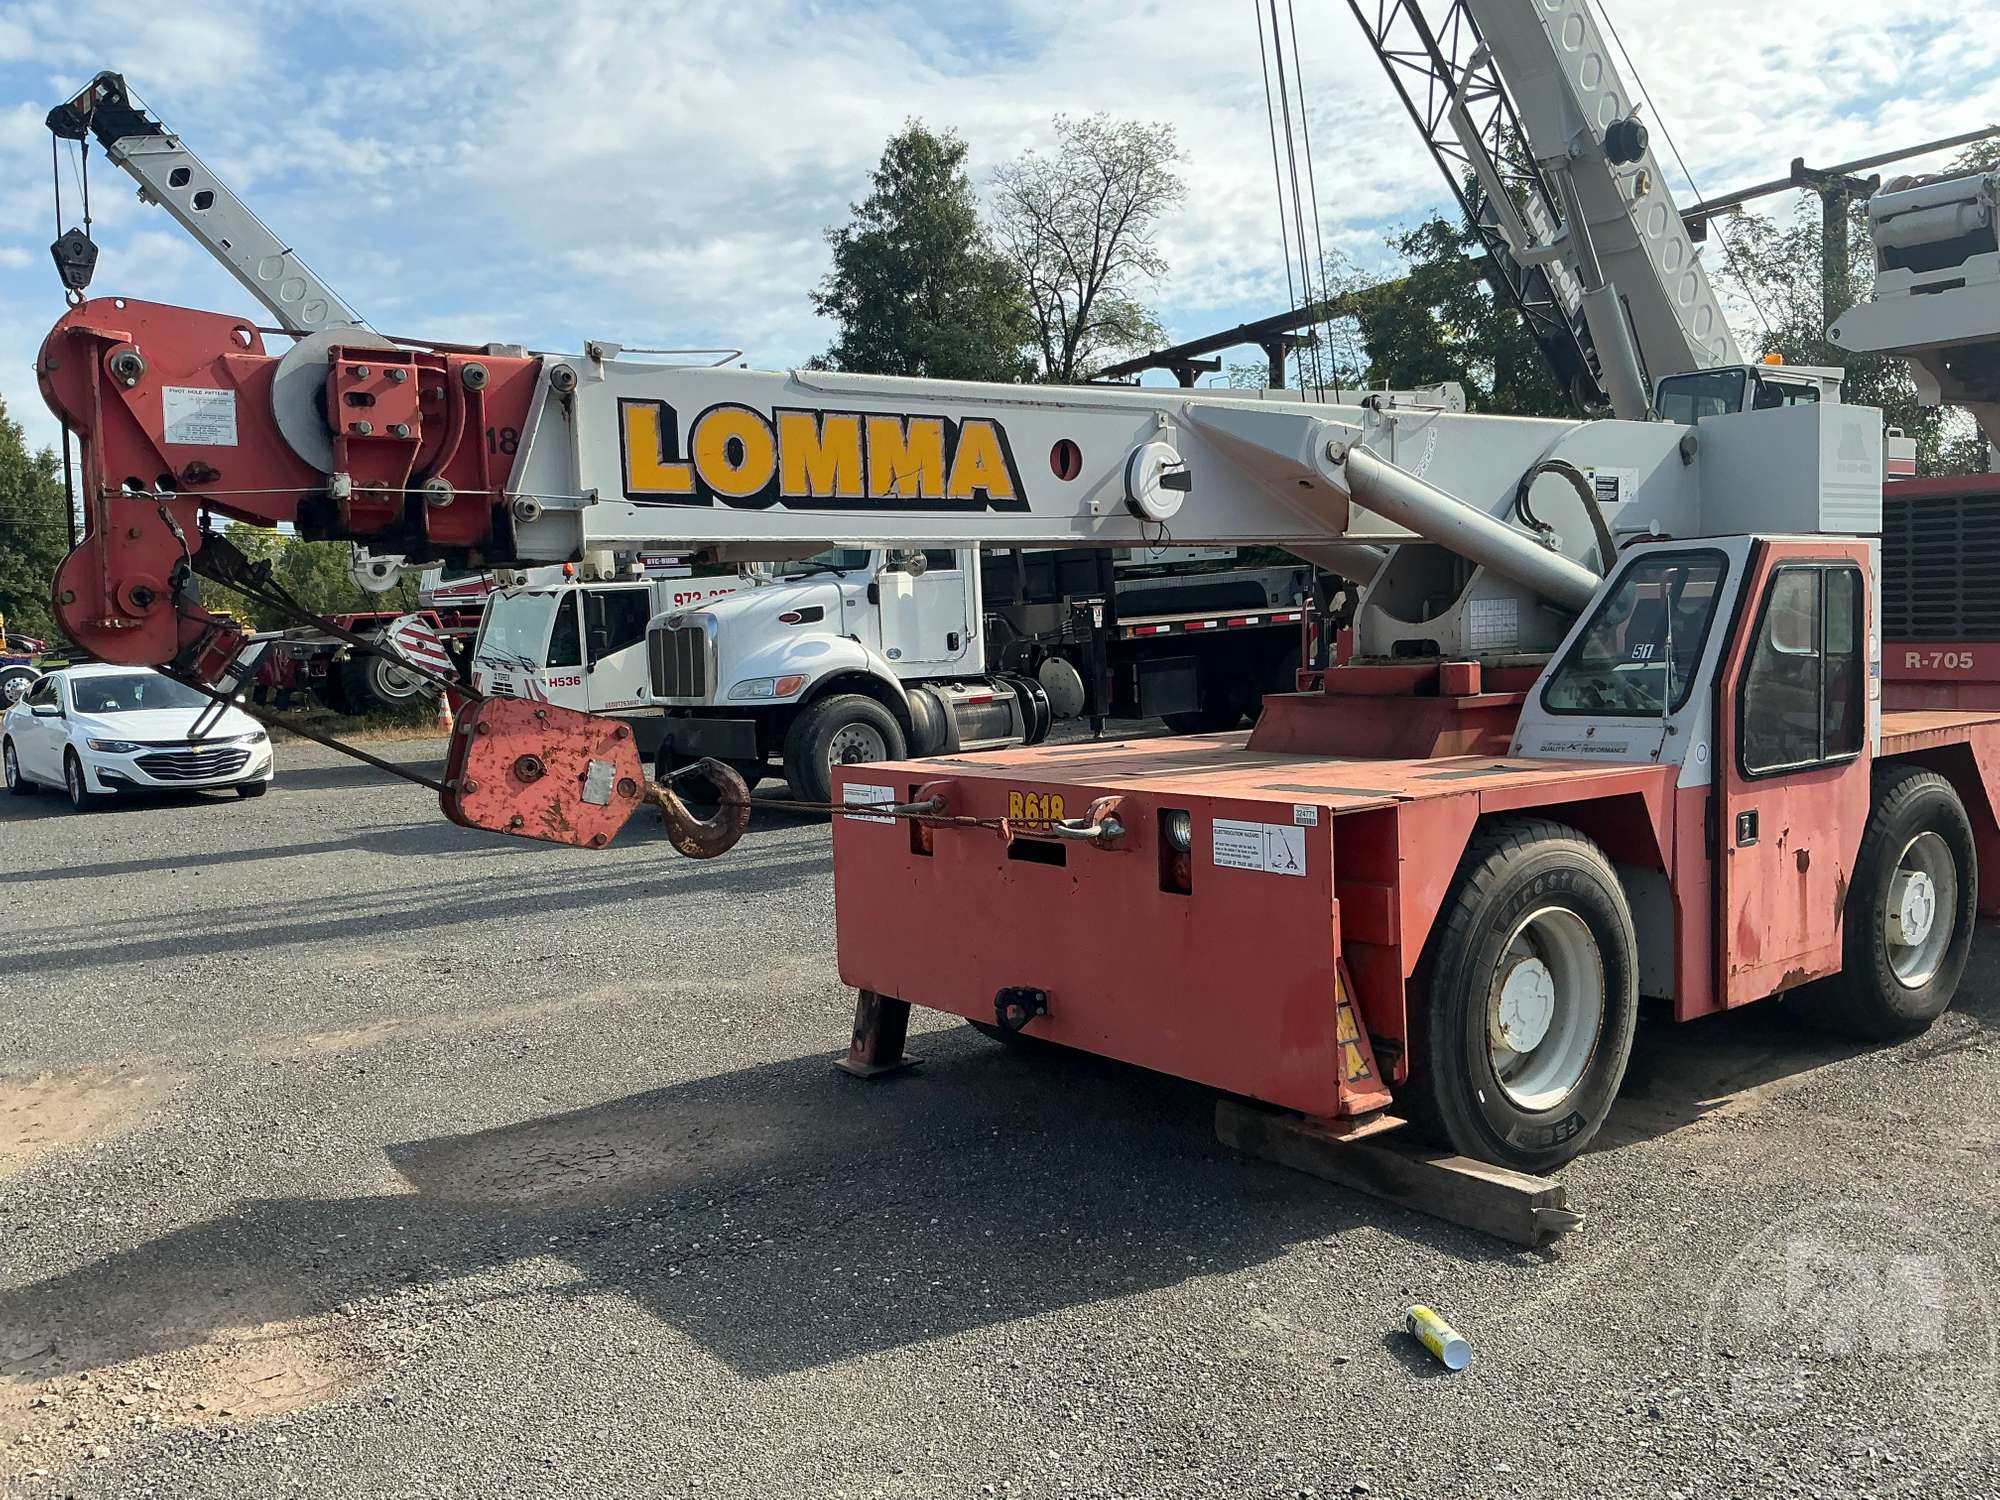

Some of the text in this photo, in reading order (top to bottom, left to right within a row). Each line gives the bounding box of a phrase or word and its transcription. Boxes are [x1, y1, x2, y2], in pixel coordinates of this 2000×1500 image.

[486, 426, 519, 456] 18
[618, 397, 1031, 513] LOMMA
[1632, 644, 1653, 659] 51
[1904, 651, 1974, 669] R-705
[549, 676, 581, 688] H536
[1007, 790, 1066, 831] R618
